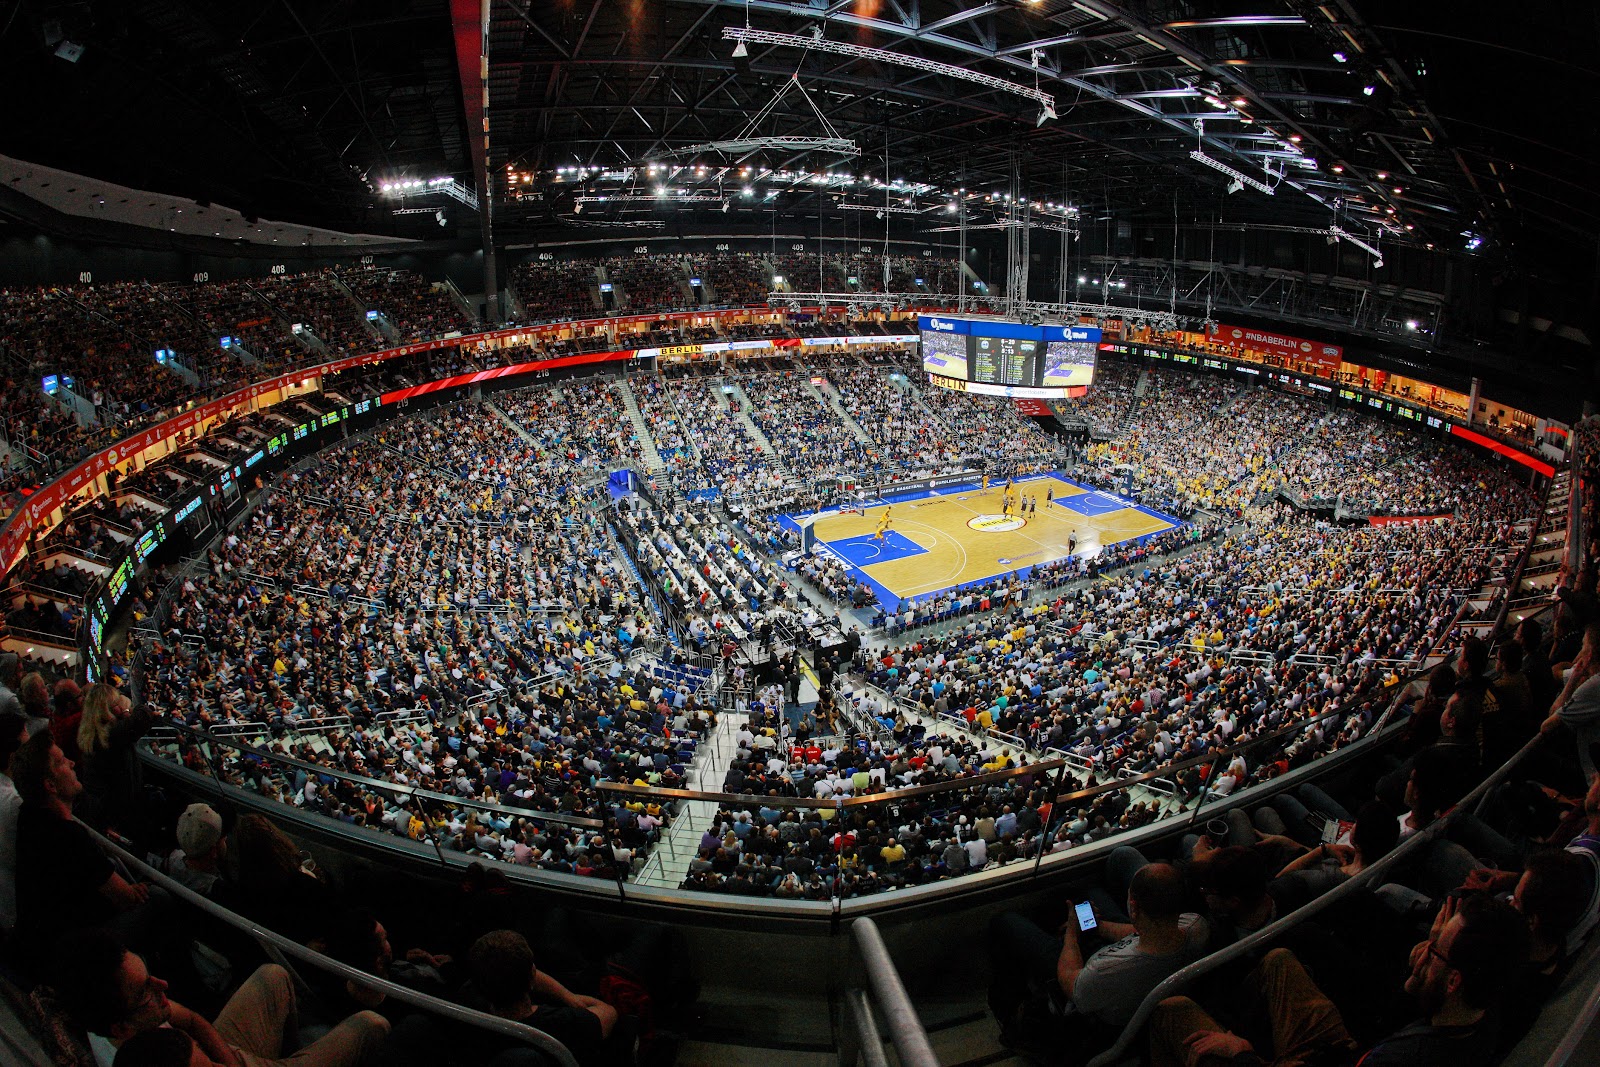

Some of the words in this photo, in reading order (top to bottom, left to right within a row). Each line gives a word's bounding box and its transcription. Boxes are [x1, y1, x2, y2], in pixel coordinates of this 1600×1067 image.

[634, 246, 648, 254] 405
[360, 256, 374, 264] 407
[538, 253, 553, 261] 406
[271, 264, 286, 275] 408
[79, 271, 92, 283] 410
[193, 272, 209, 283] 409
[1245, 331, 1297, 349] #NBABERLIN
[661, 345, 702, 355] BERLIN
[536, 369, 550, 378] 218
[931, 374, 967, 391] BERLIN
[396, 398, 409, 408] 219
